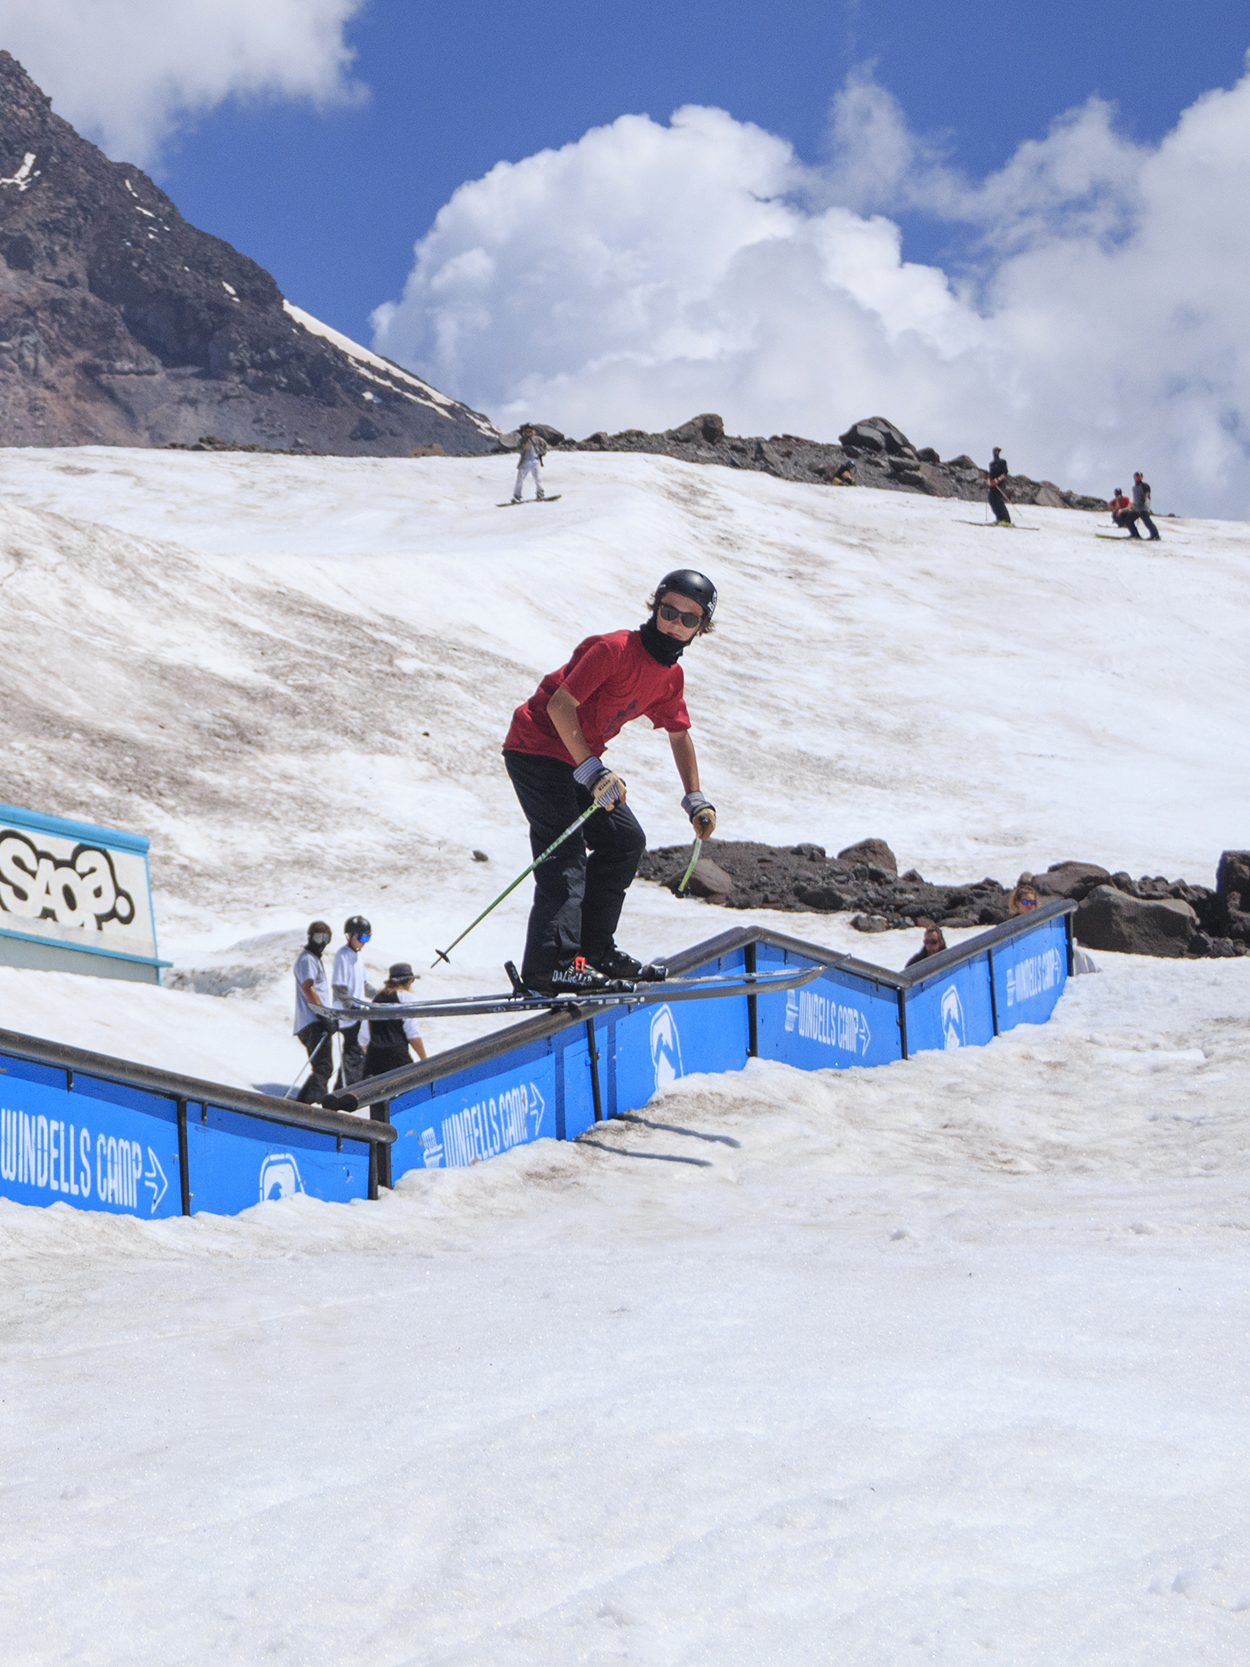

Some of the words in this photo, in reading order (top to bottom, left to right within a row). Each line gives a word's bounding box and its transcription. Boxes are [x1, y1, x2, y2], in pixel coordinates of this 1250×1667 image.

[798, 990, 837, 1047] WINDELLS
[838, 1004, 859, 1054] CAMP
[0, 1107, 92, 1199] WINDELLS
[96, 1132, 143, 1209] CAMP
[441, 1097, 501, 1168] WINDELLS
[498, 1083, 528, 1150] CAMP
